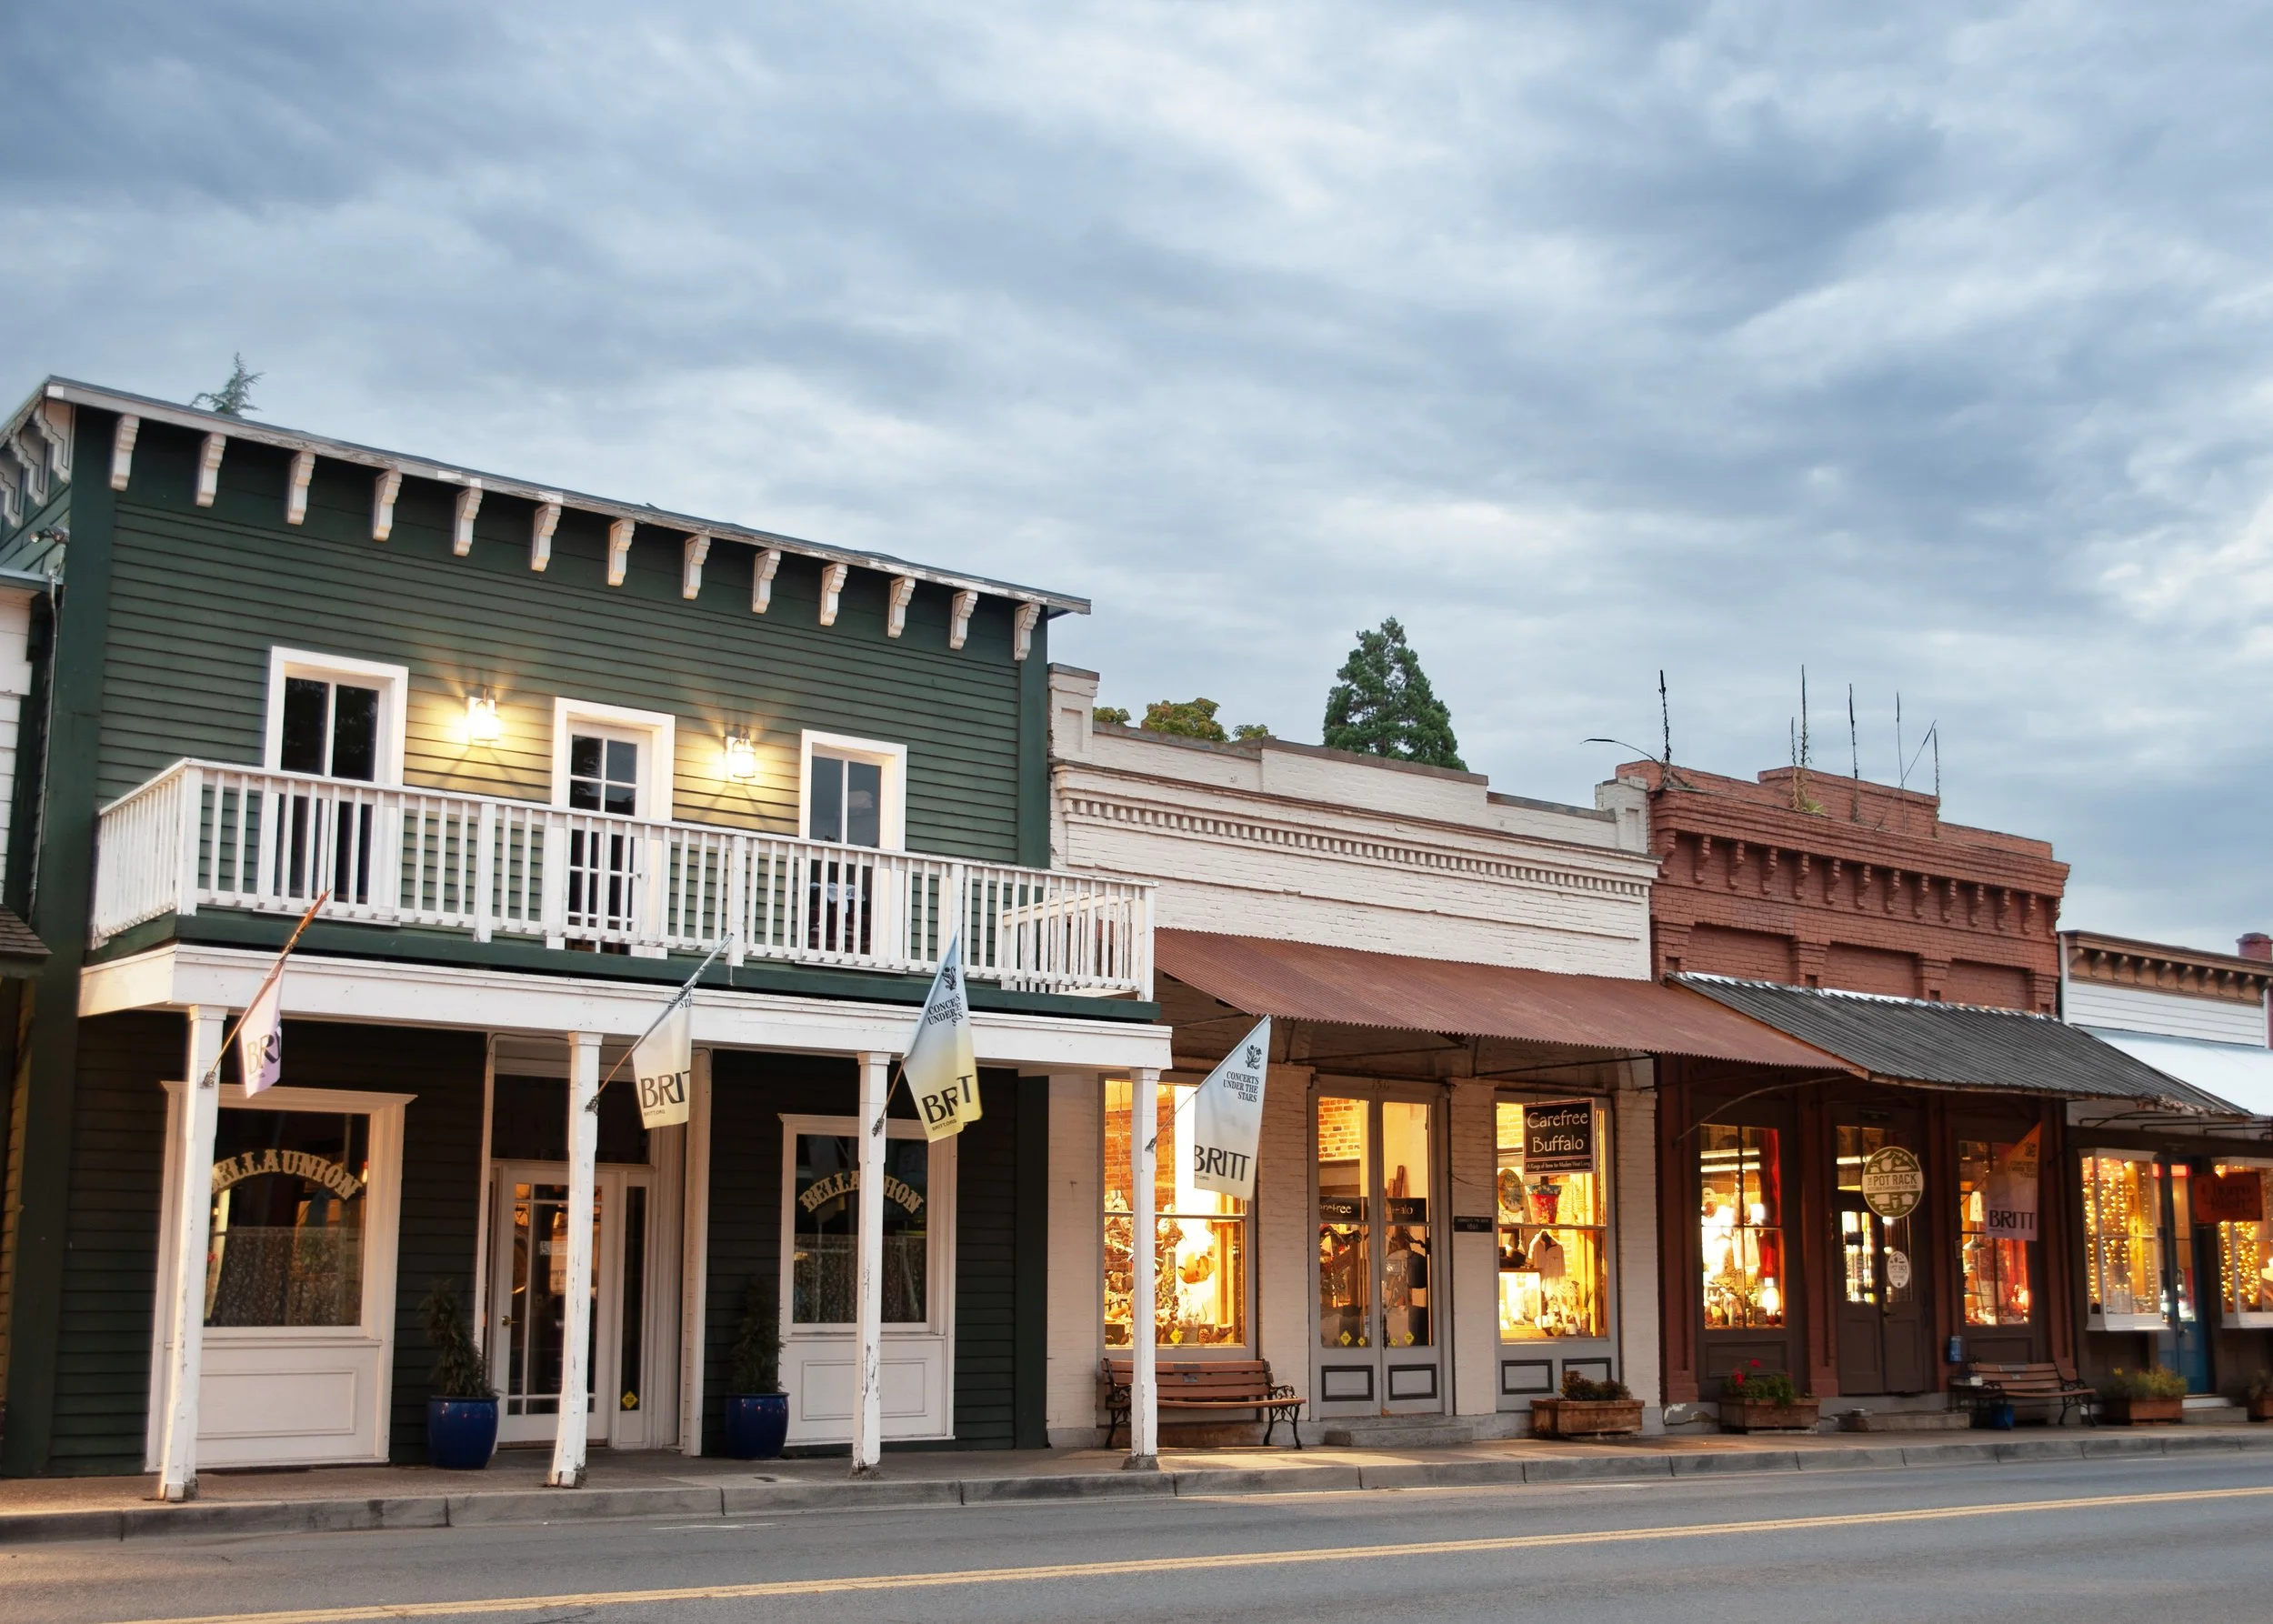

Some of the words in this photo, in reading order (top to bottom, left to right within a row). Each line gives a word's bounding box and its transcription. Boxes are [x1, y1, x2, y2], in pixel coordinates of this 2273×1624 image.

[1223, 1079, 1245, 1091] UNDER
[1245, 1083, 1258, 1094] THE
[1227, 1070, 1259, 1085] CONCERTS
[921, 1074, 974, 1124] BRT
[1237, 1091, 1257, 1103] STARS
[1527, 1109, 1588, 1128] Carefree
[1532, 1134, 1584, 1153] Buffalo
[1194, 1144, 1251, 1181] BRITT
[1873, 1175, 1891, 1187] POT
[1892, 1173, 1918, 1186] RACK
[1988, 1209, 2036, 1229] BRITT
